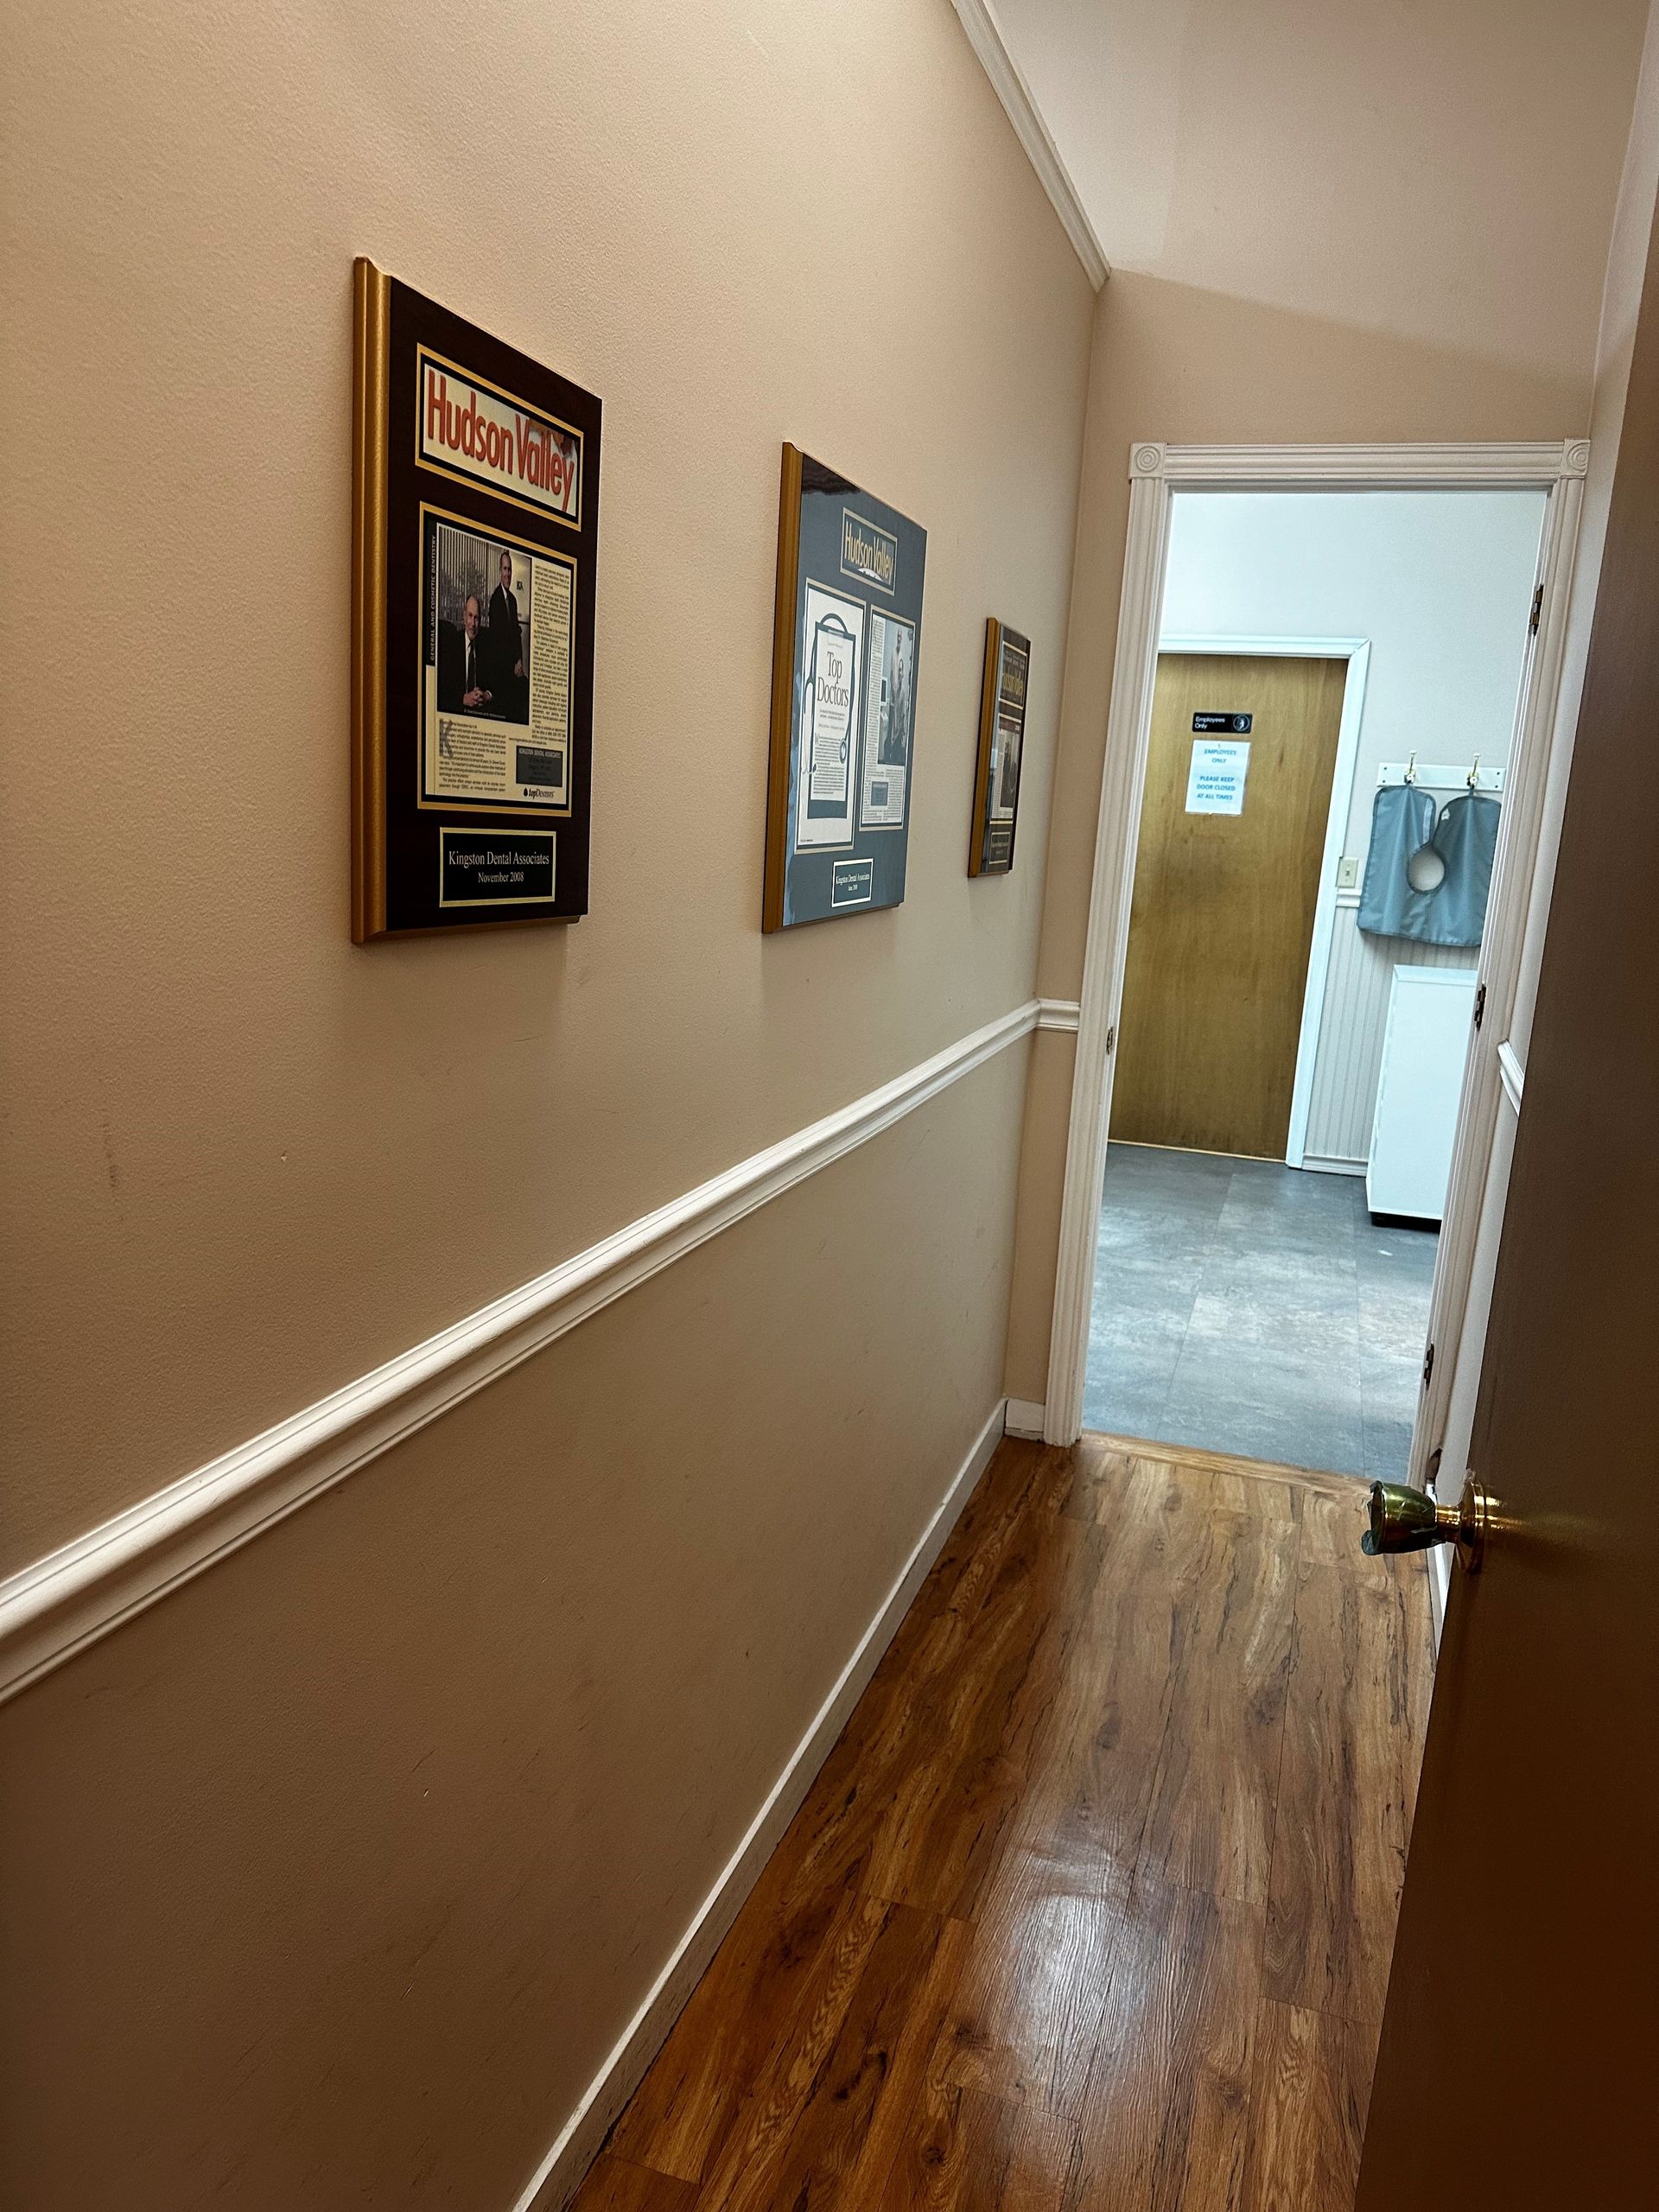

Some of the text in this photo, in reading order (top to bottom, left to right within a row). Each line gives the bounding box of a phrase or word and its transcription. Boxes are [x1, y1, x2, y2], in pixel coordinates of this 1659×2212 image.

[429, 369, 575, 512] Hudson Valley
[844, 520, 893, 585] Hudson Valley
[827, 652, 842, 683] Top
[817, 677, 849, 706] Doctors
[448, 850, 550, 868] Kingston Dental Associates
[478, 872, 524, 883] November 2008
